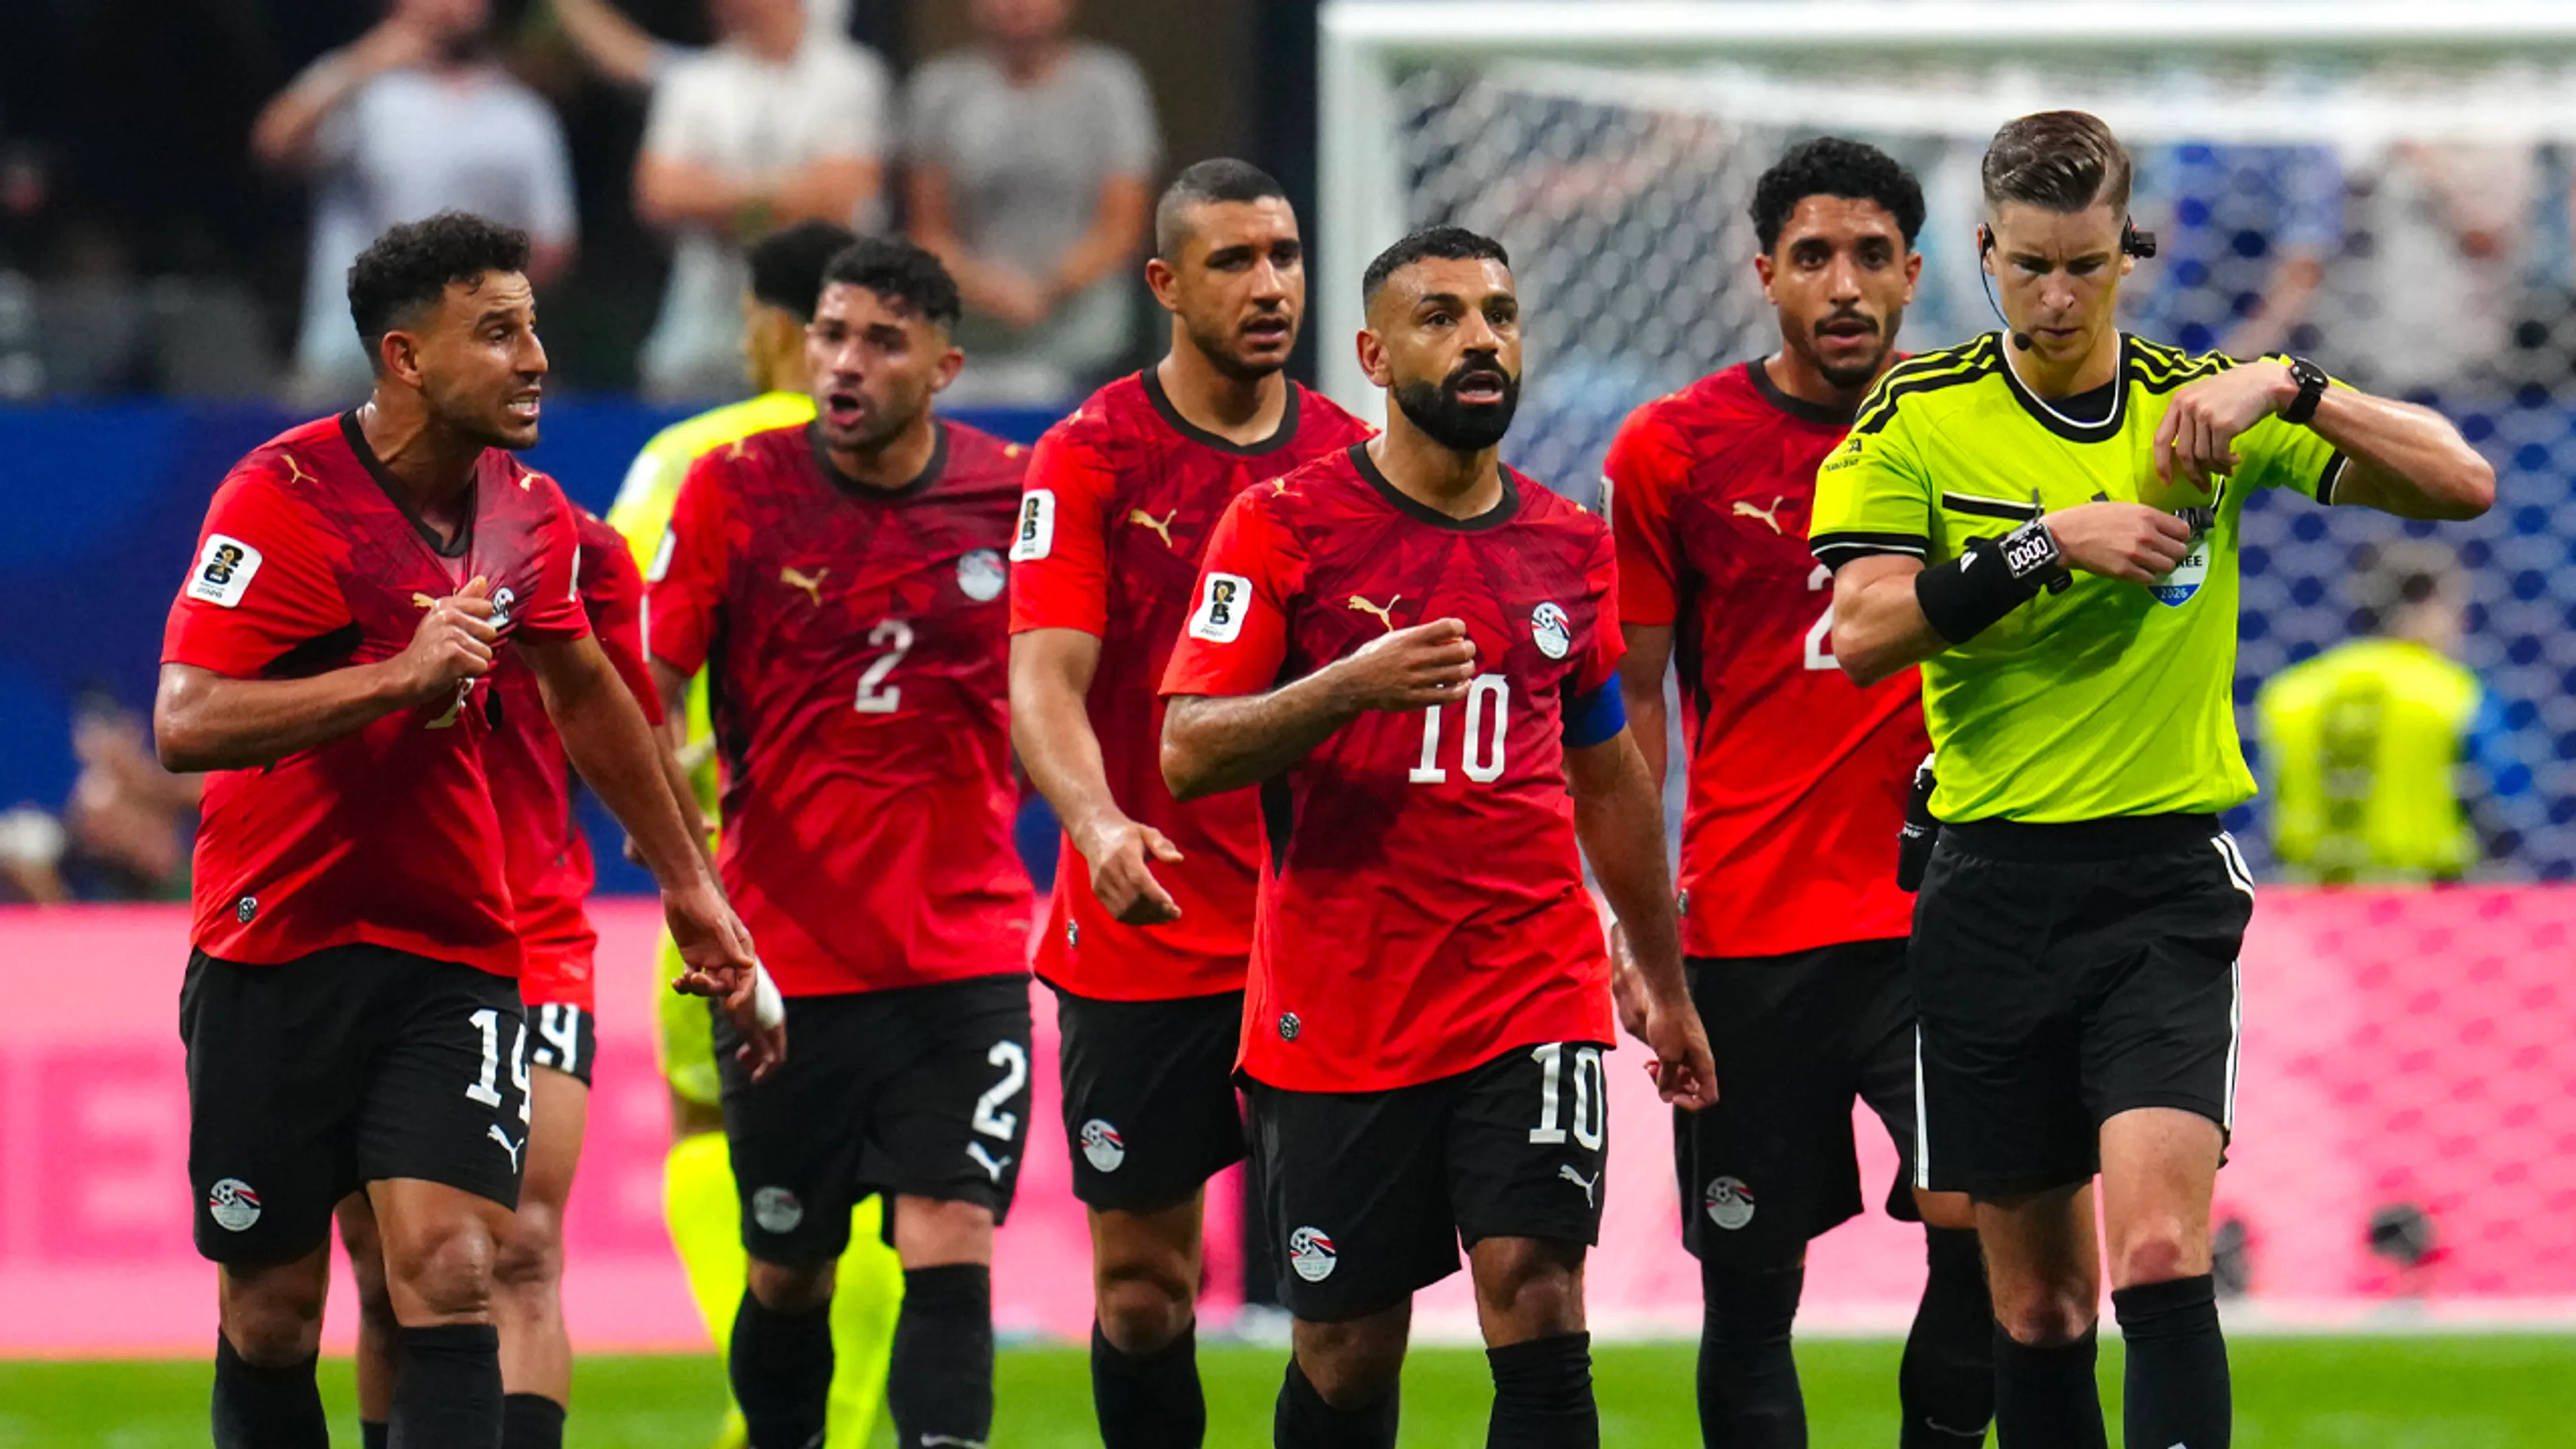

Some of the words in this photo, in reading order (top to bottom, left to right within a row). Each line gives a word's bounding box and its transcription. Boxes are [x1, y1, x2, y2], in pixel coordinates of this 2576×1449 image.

[2161, 587, 2189, 599] 2026
[853, 617, 914, 713] 2
[1409, 673, 1509, 784] 10
[971, 1039, 1027, 1142] 2
[1529, 1041, 1603, 1152] 10
